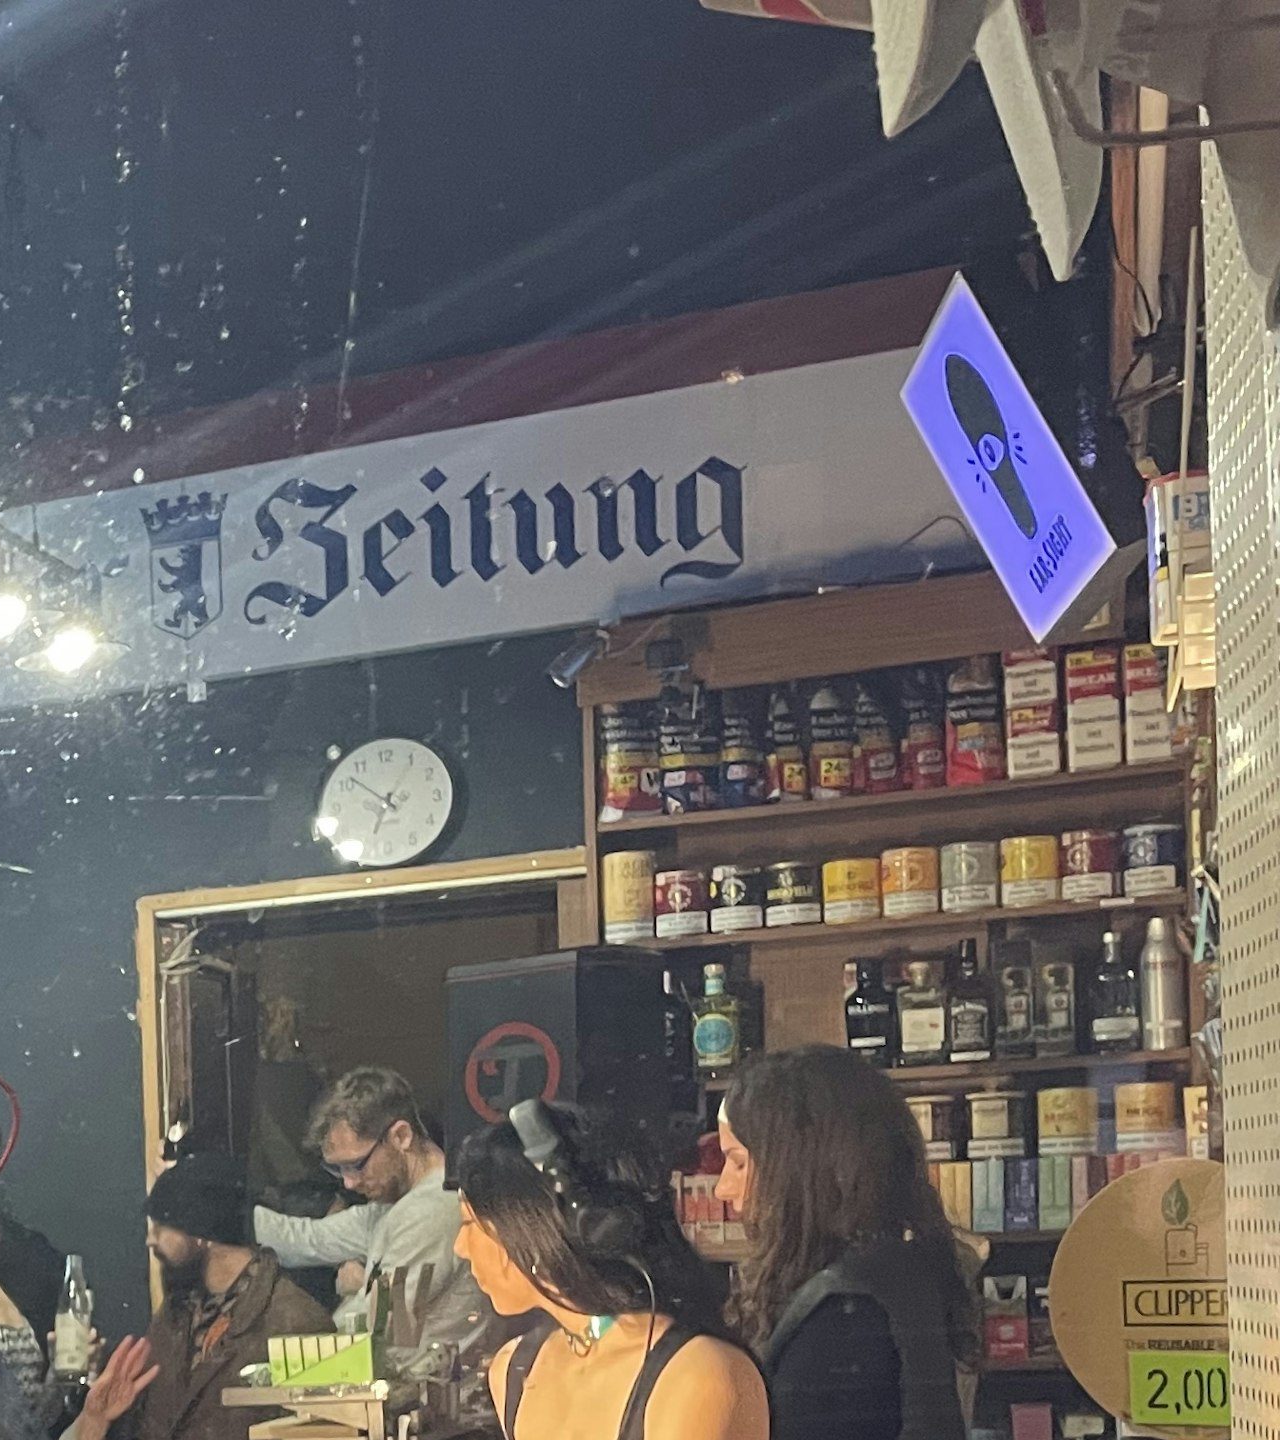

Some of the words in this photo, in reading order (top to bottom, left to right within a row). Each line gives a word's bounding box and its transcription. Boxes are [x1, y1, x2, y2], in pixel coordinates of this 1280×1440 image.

[243, 455, 749, 627] Zeitung
[377, 750, 394, 763] 12
[408, 753, 415, 767] 1
[353, 760, 367, 773] 11
[425, 767, 434, 781] 2
[432, 788, 442, 802] 3
[1146, 1367, 1228, 1415] 2,00
